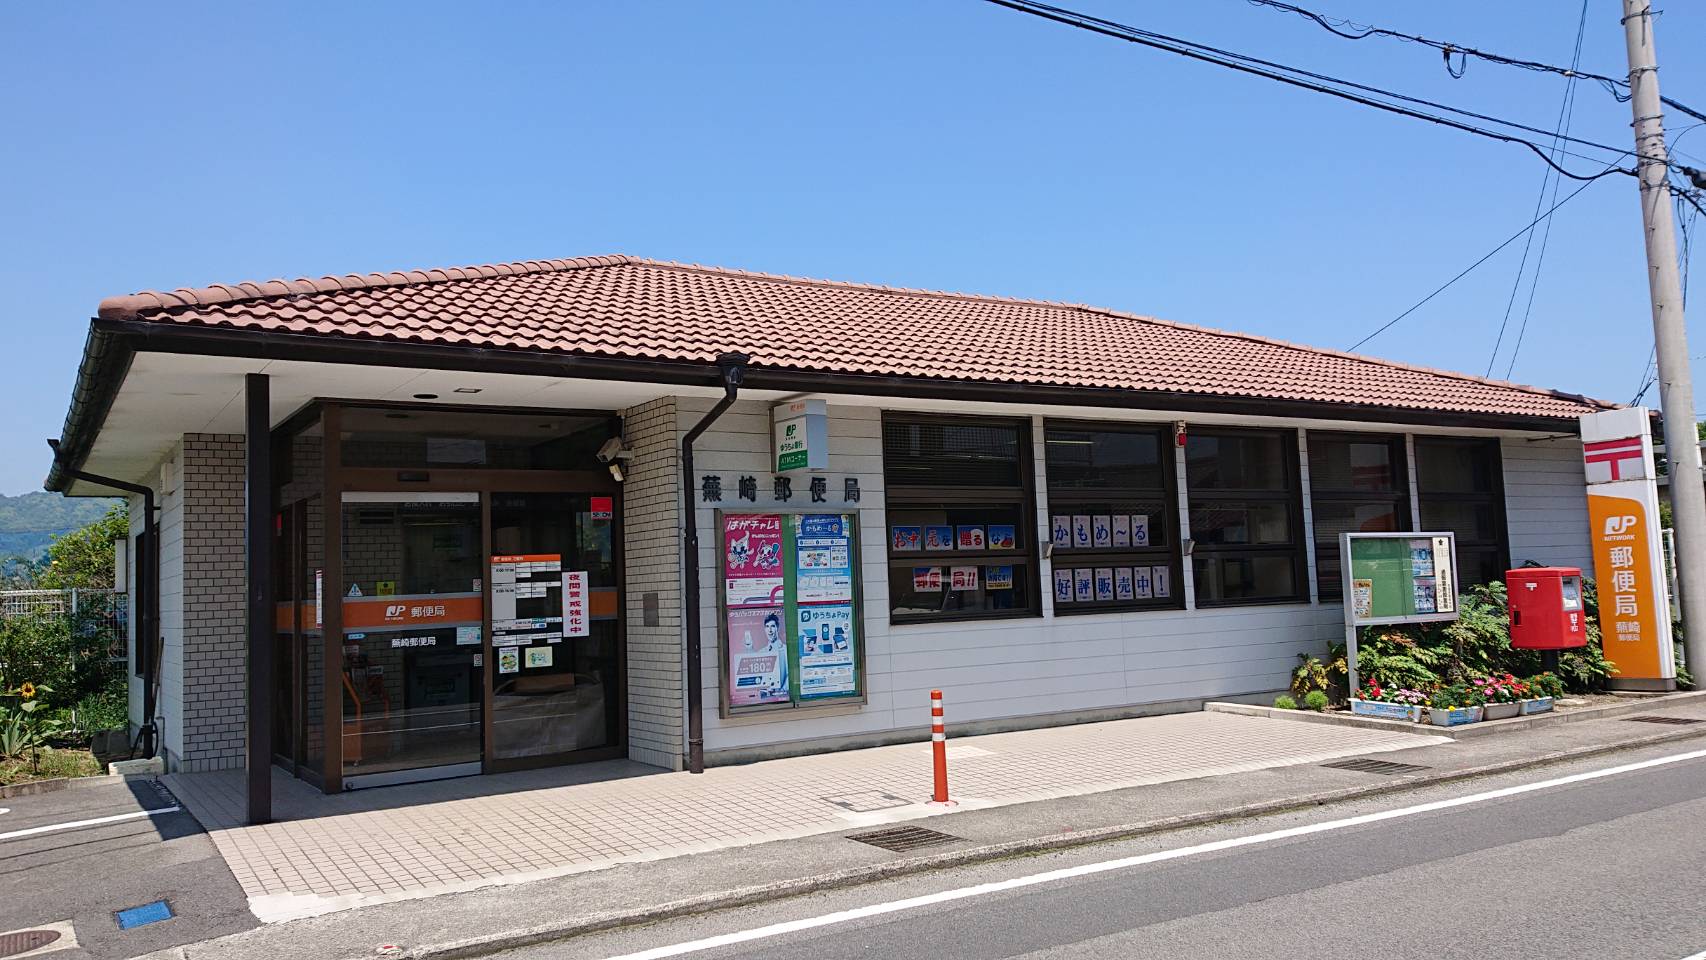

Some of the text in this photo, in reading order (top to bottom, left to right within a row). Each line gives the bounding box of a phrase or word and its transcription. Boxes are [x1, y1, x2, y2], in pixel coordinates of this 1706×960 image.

[702, 475, 861, 502] 蕪崎郵便局
[1605, 515, 1638, 535] JP
[1056, 575, 1163, 595] 好評販売中!
[1609, 546, 1639, 616] 郵便局
[385, 605, 406, 617] JP
[411, 605, 445, 618] 郵便局
[569, 574, 582, 633] 夜間警戒強化中
[813, 610, 850, 620] ゆうちょPay
[1615, 621, 1641, 633] 蕪崎
[392, 636, 437, 648] 蕪崎郵便局
